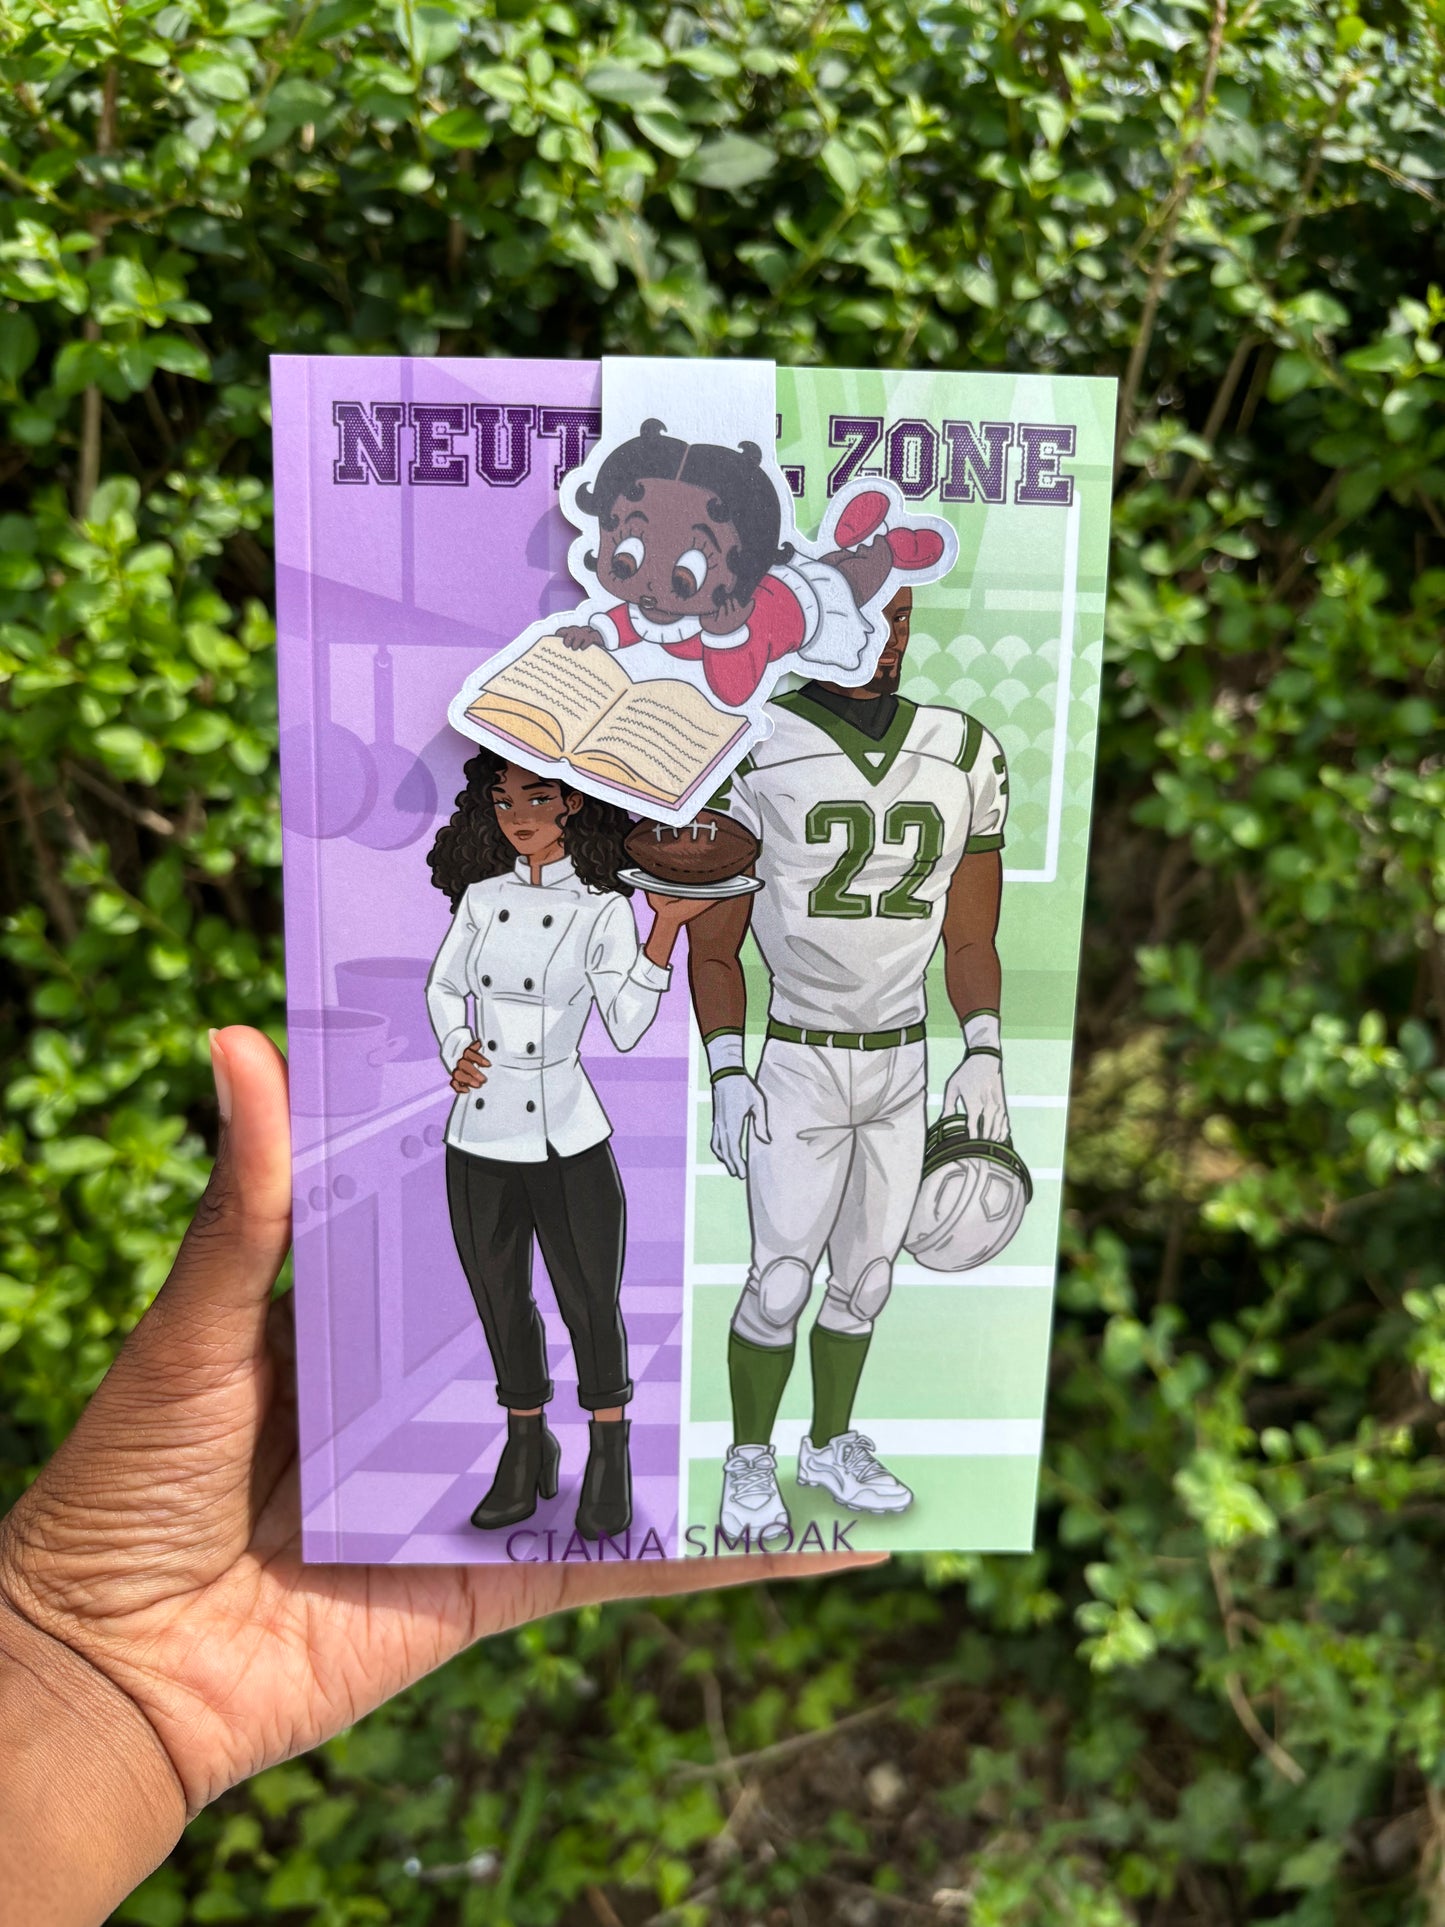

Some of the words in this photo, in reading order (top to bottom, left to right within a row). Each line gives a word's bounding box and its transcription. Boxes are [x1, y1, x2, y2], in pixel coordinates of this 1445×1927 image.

[333, 401, 805, 498] NEUT
[827, 415, 1077, 507] ZONE
[805, 800, 945, 919] 22
[505, 1527, 667, 1562] CIANA
[684, 1519, 859, 1557] SMOAK
